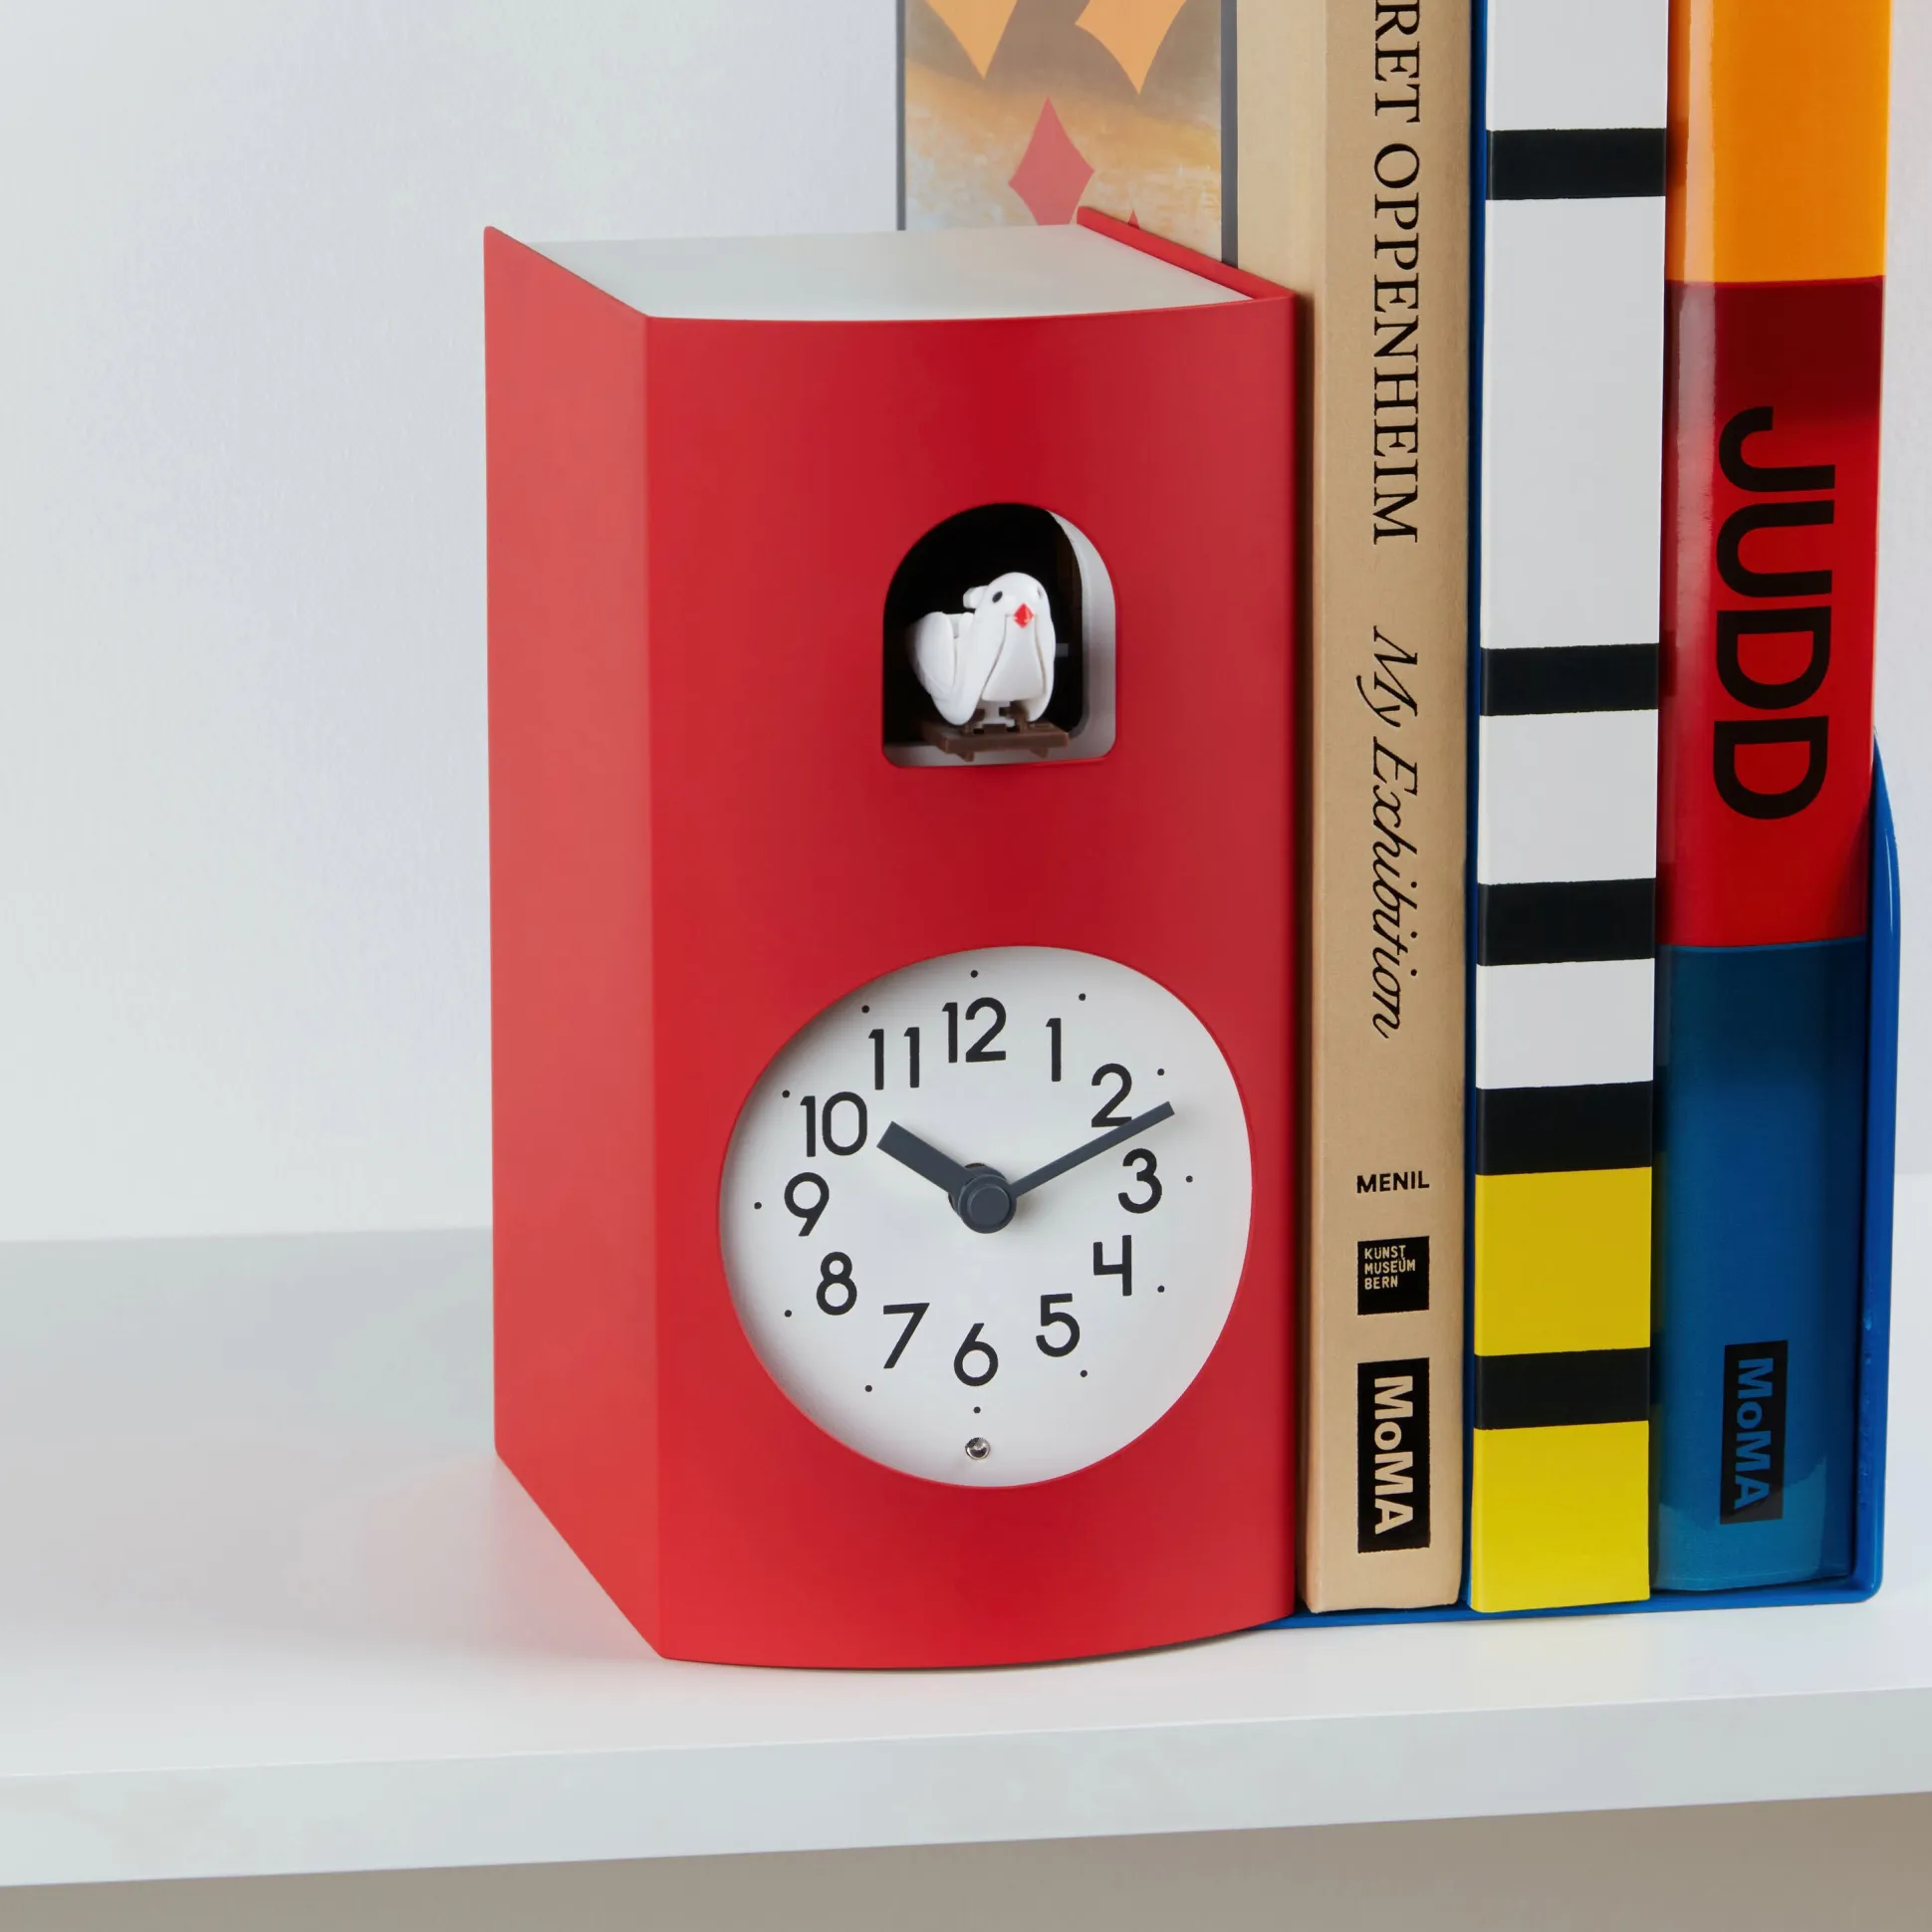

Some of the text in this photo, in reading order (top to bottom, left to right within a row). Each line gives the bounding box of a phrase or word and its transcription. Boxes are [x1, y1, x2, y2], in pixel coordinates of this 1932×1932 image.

[1373, 142, 1420, 546] OPPENHEIM
[1713, 405, 1835, 820] JUDD
[1355, 624, 1418, 1040] My Exhibition
[868, 1027, 920, 1090] 11
[942, 997, 1007, 1063] 12
[1046, 1018, 1062, 1083] 1
[800, 1091, 868, 1158] 10
[1090, 1063, 1133, 1128] 2
[784, 1172, 830, 1237] 9
[1117, 1148, 1163, 1214] 3
[1356, 1170, 1430, 1194] MENIL
[816, 1251, 857, 1316] 8
[1092, 1235, 1132, 1297] 4
[1364, 1245, 1406, 1260] KUNST
[1364, 1258, 1416, 1275] MUSEUM
[1364, 1276, 1398, 1290] BERN
[883, 1302, 930, 1369] 7
[953, 1323, 999, 1387] 6
[1036, 1293, 1081, 1357] 5
[1374, 1375, 1414, 1535] MoMA
[1735, 1357, 1774, 1509] MoMA
